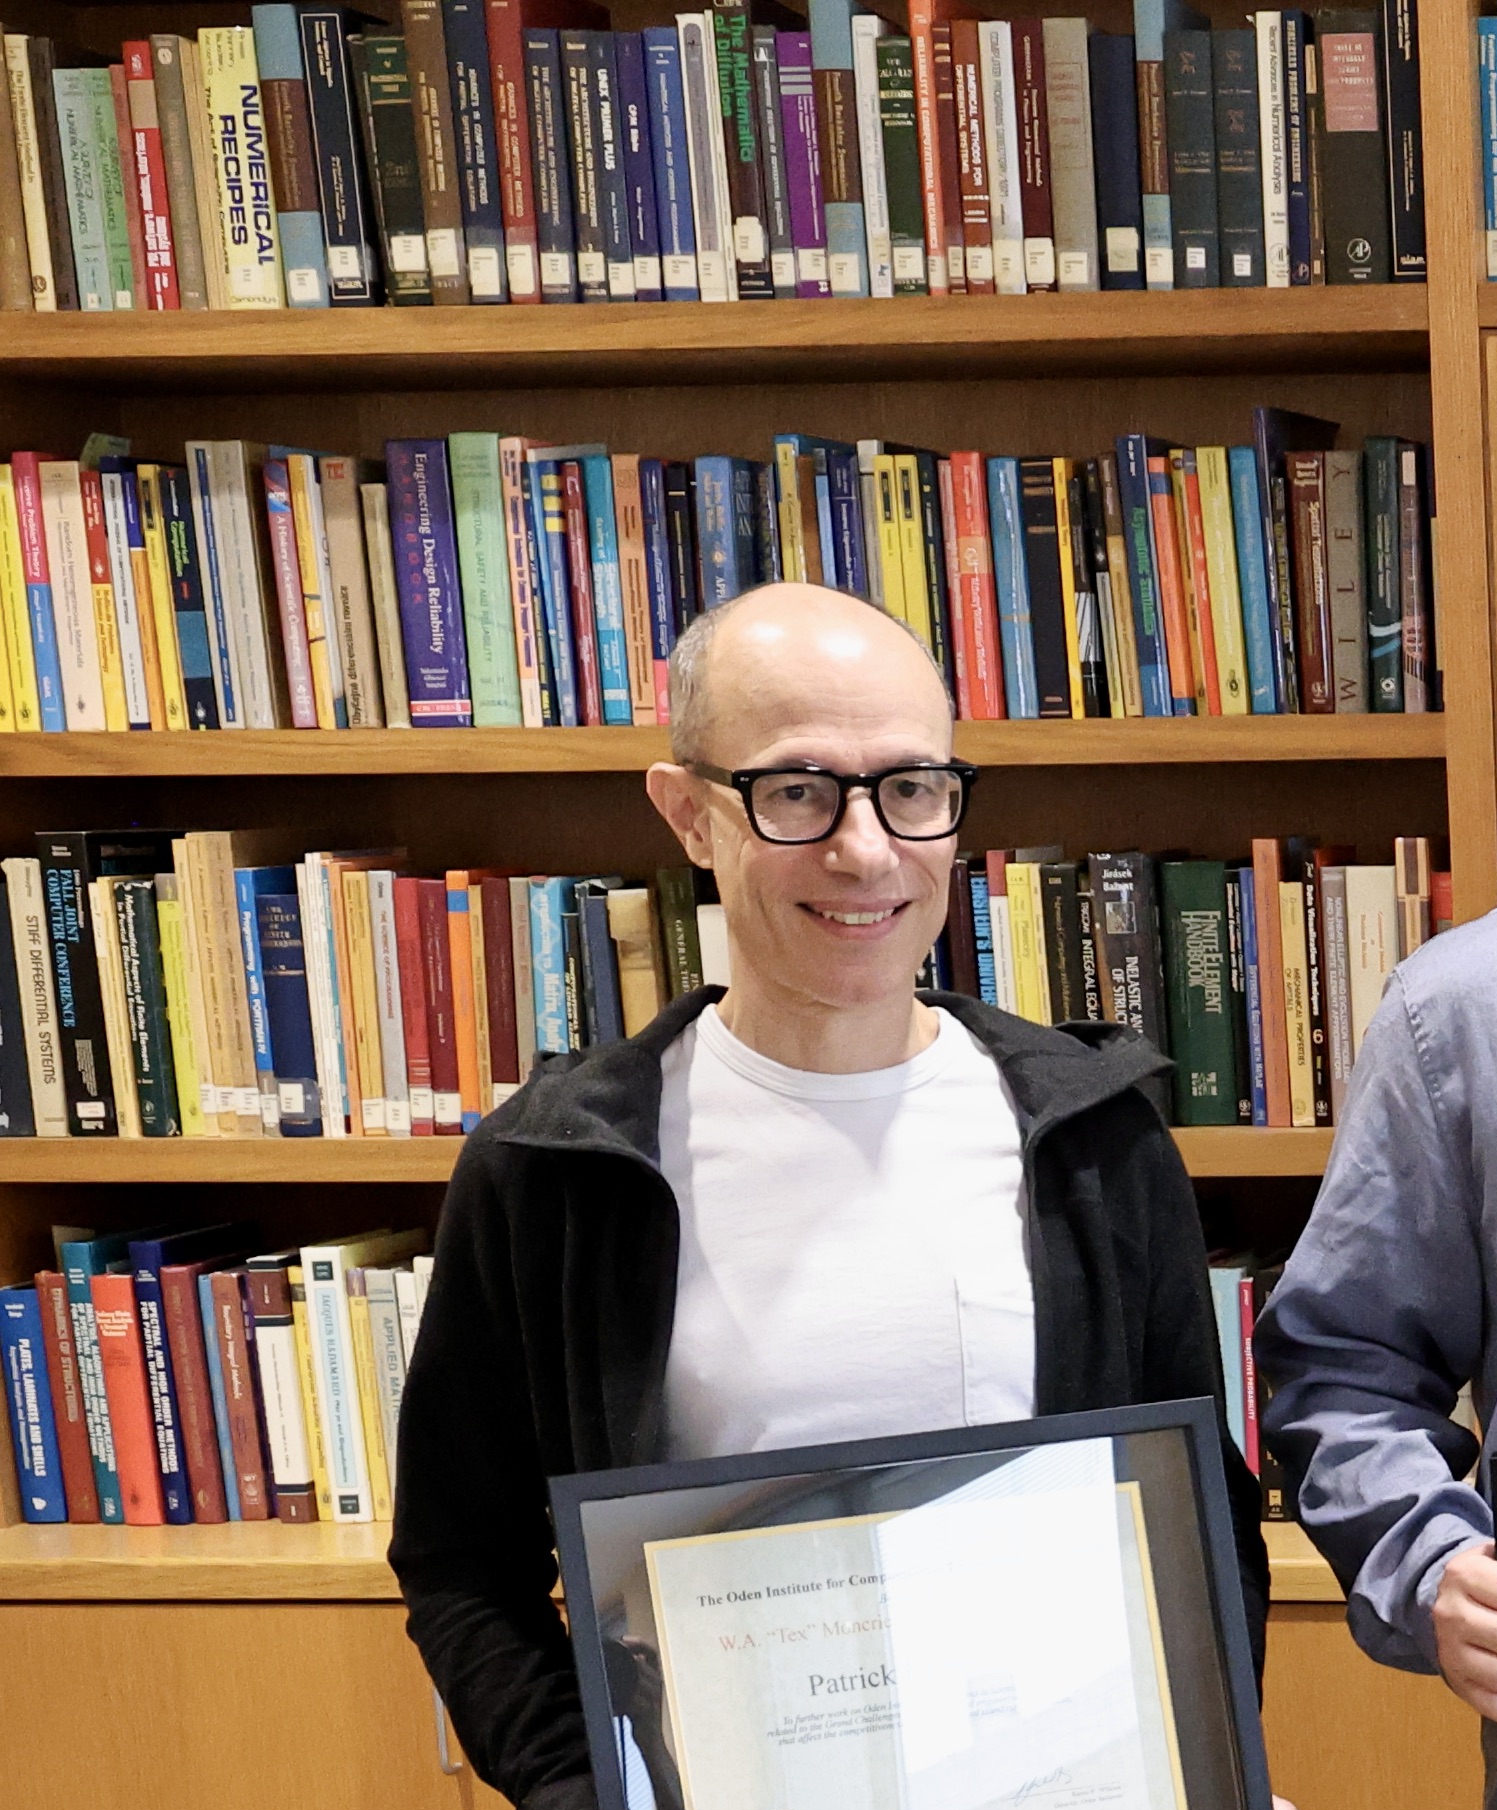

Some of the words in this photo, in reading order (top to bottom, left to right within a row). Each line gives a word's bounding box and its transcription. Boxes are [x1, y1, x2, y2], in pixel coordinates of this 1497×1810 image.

[714, 15, 727, 31] of
[730, 16, 747, 48] The
[597, 69, 612, 97] UNIX
[716, 40, 734, 117] Diffusion
[599, 101, 614, 141] PRIMER
[240, 85, 274, 265] NUMERICAL
[603, 143, 615, 170] PLUS
[219, 115, 248, 245] RECIPES
[414, 453, 432, 534] Engineering
[423, 539, 439, 584] Design
[427, 588, 444, 654] Reliability
[60, 869, 74, 901] FALL
[26, 915, 40, 945] STIFF
[65, 904, 79, 943] JOINT
[1202, 911, 1222, 952] FINITE
[47, 869, 64, 940] COMPUTER
[56, 942, 76, 1027] CONFERENCE
[1181, 911, 1206, 988] HANDBOOK
[29, 949, 49, 1026] DIFFERENTIAL
[1203, 953, 1223, 1014] ELEMENT
[38, 1032, 56, 1084] SYSTEMS
[18, 1338, 35, 1371] PLATES,
[21, 1373, 40, 1421] LAMINATES
[25, 1423, 42, 1441] AND
[26, 1444, 46, 1476] SHELLS
[697, 1593, 723, 1607] The
[727, 1588, 763, 1604] Oden
[766, 1582, 823, 1600] Institute
[826, 1579, 846, 1592] for
[719, 1632, 761, 1652] W.A.
[822, 1617, 891, 1638] Moncrie
[809, 1666, 897, 1697] Patrick
